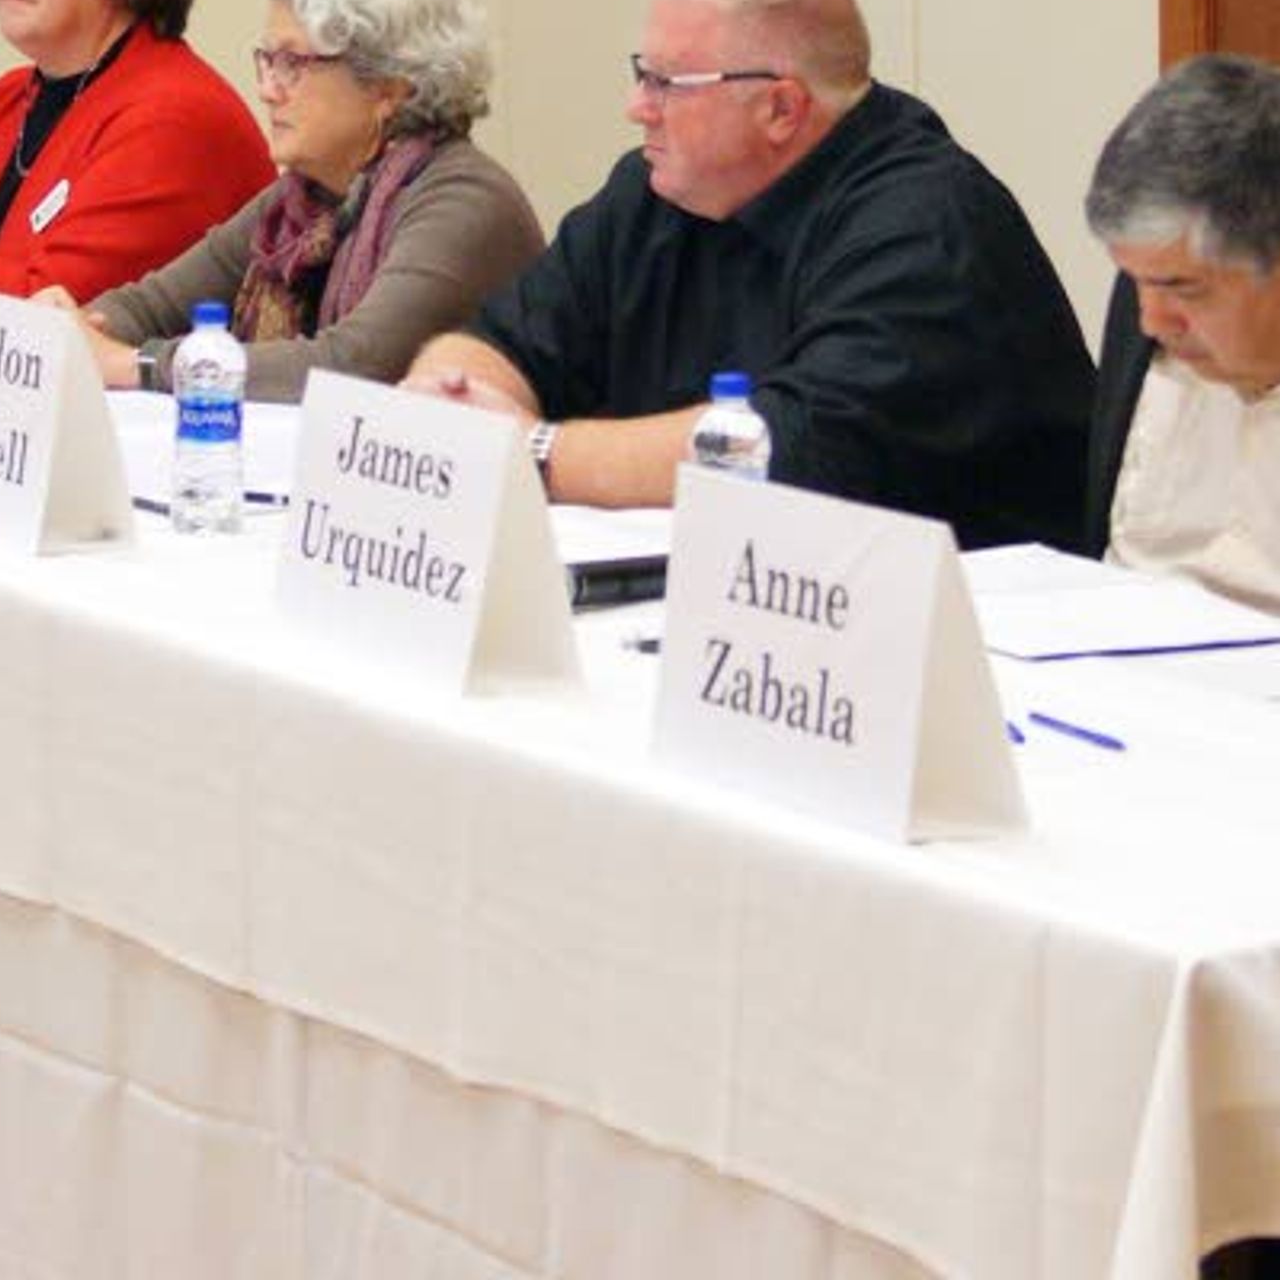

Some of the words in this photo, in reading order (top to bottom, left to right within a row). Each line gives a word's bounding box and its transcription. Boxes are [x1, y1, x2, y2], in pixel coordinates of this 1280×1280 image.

[338, 415, 455, 499] James
[300, 499, 468, 604] Urquidez
[727, 539, 850, 631] Anne
[699, 638, 856, 745] Zabala
